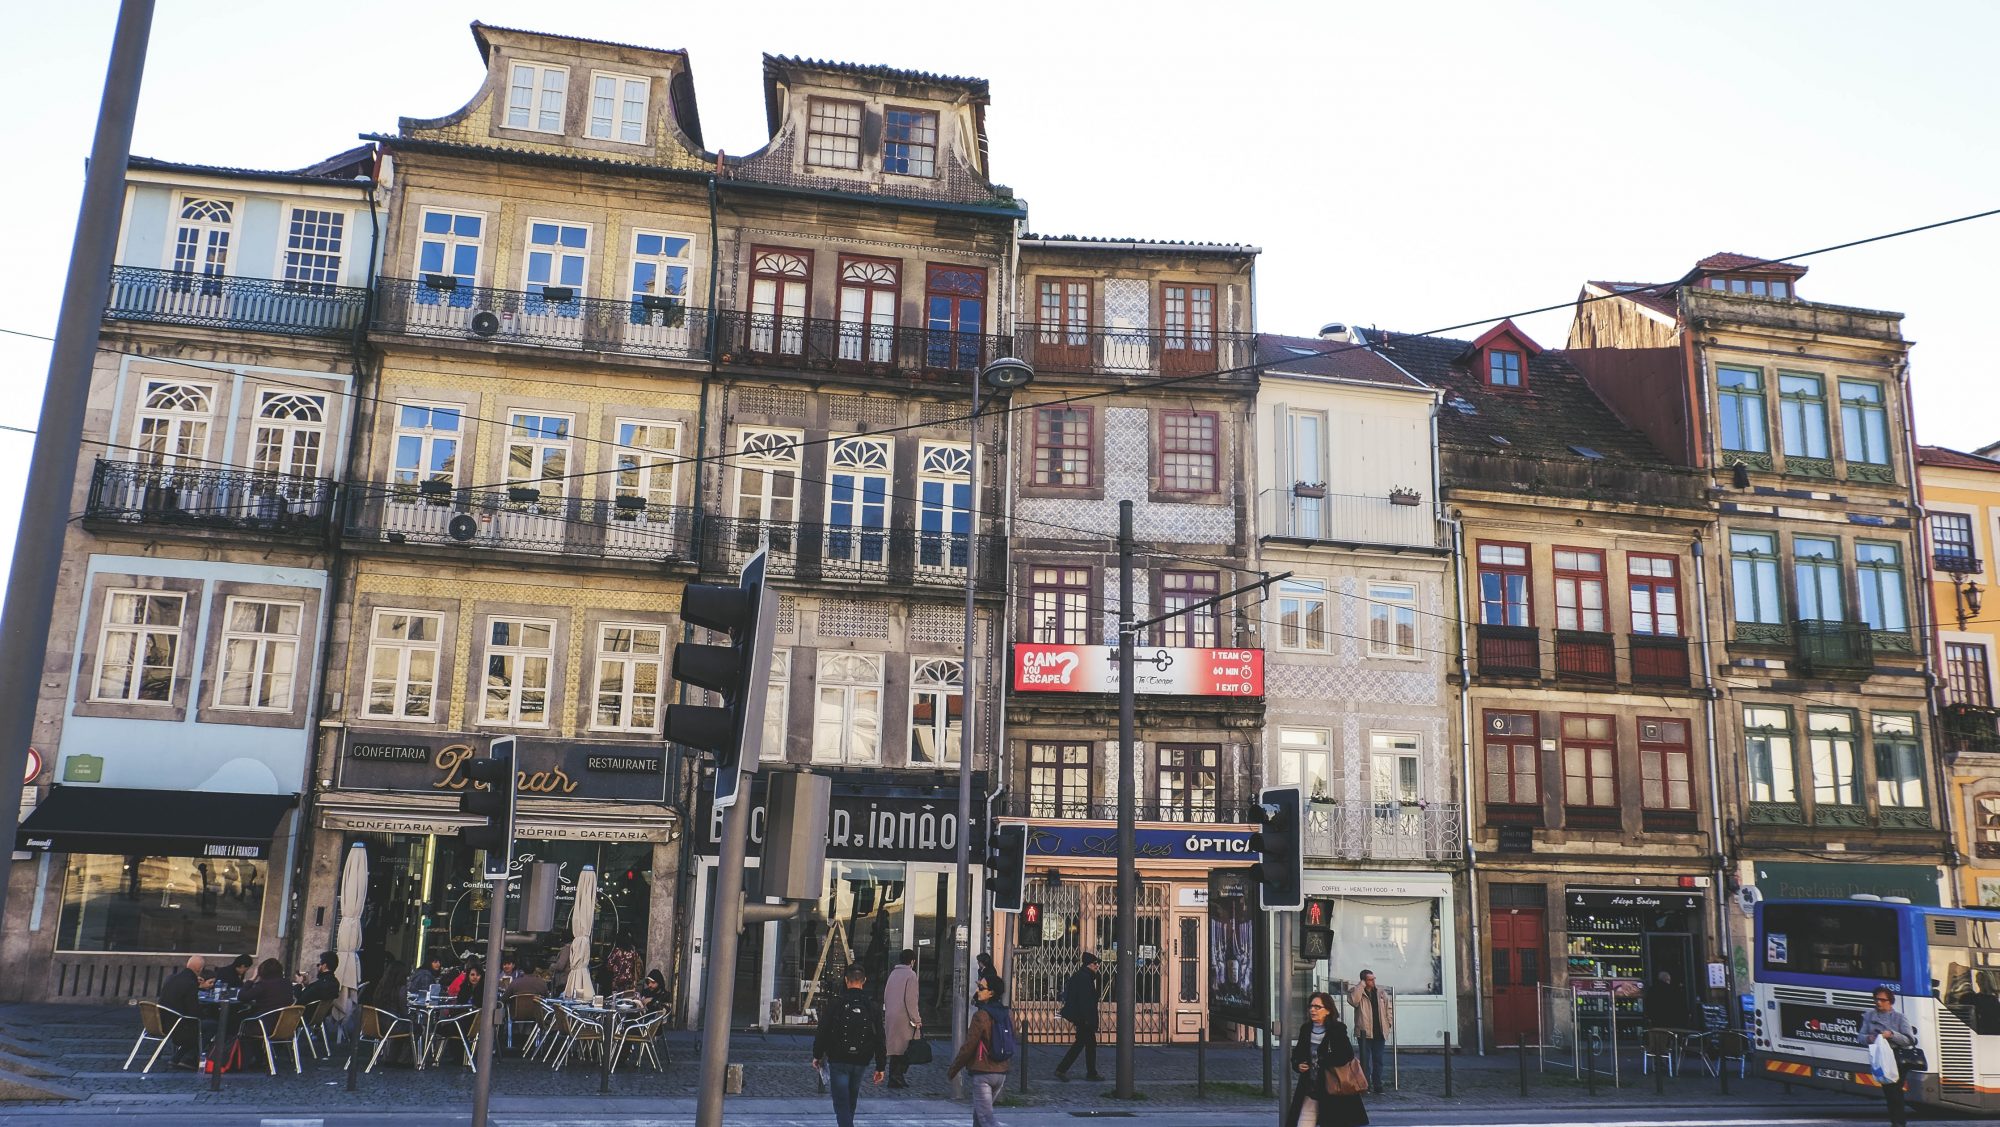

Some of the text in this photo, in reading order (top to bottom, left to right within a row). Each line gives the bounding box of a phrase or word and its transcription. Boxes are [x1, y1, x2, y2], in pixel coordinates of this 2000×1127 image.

[1023, 651, 1056, 667] CAN
[1218, 652, 1239, 660] TEAM
[1023, 666, 1040, 674] YOU
[1213, 667, 1223, 675] 60
[1023, 674, 1060, 684] ESCAPE
[353, 745, 426, 760] CONFEITARIA
[588, 757, 658, 771] RESTAURANTE
[346, 820, 434, 832] CONFEITARIA
[580, 830, 649, 839] CAFETARIA
[1795, 1029, 1812, 1038] FELIZ
[1811, 1031, 1831, 1040] NATAL
[1836, 1035, 1852, 1043] BOM
